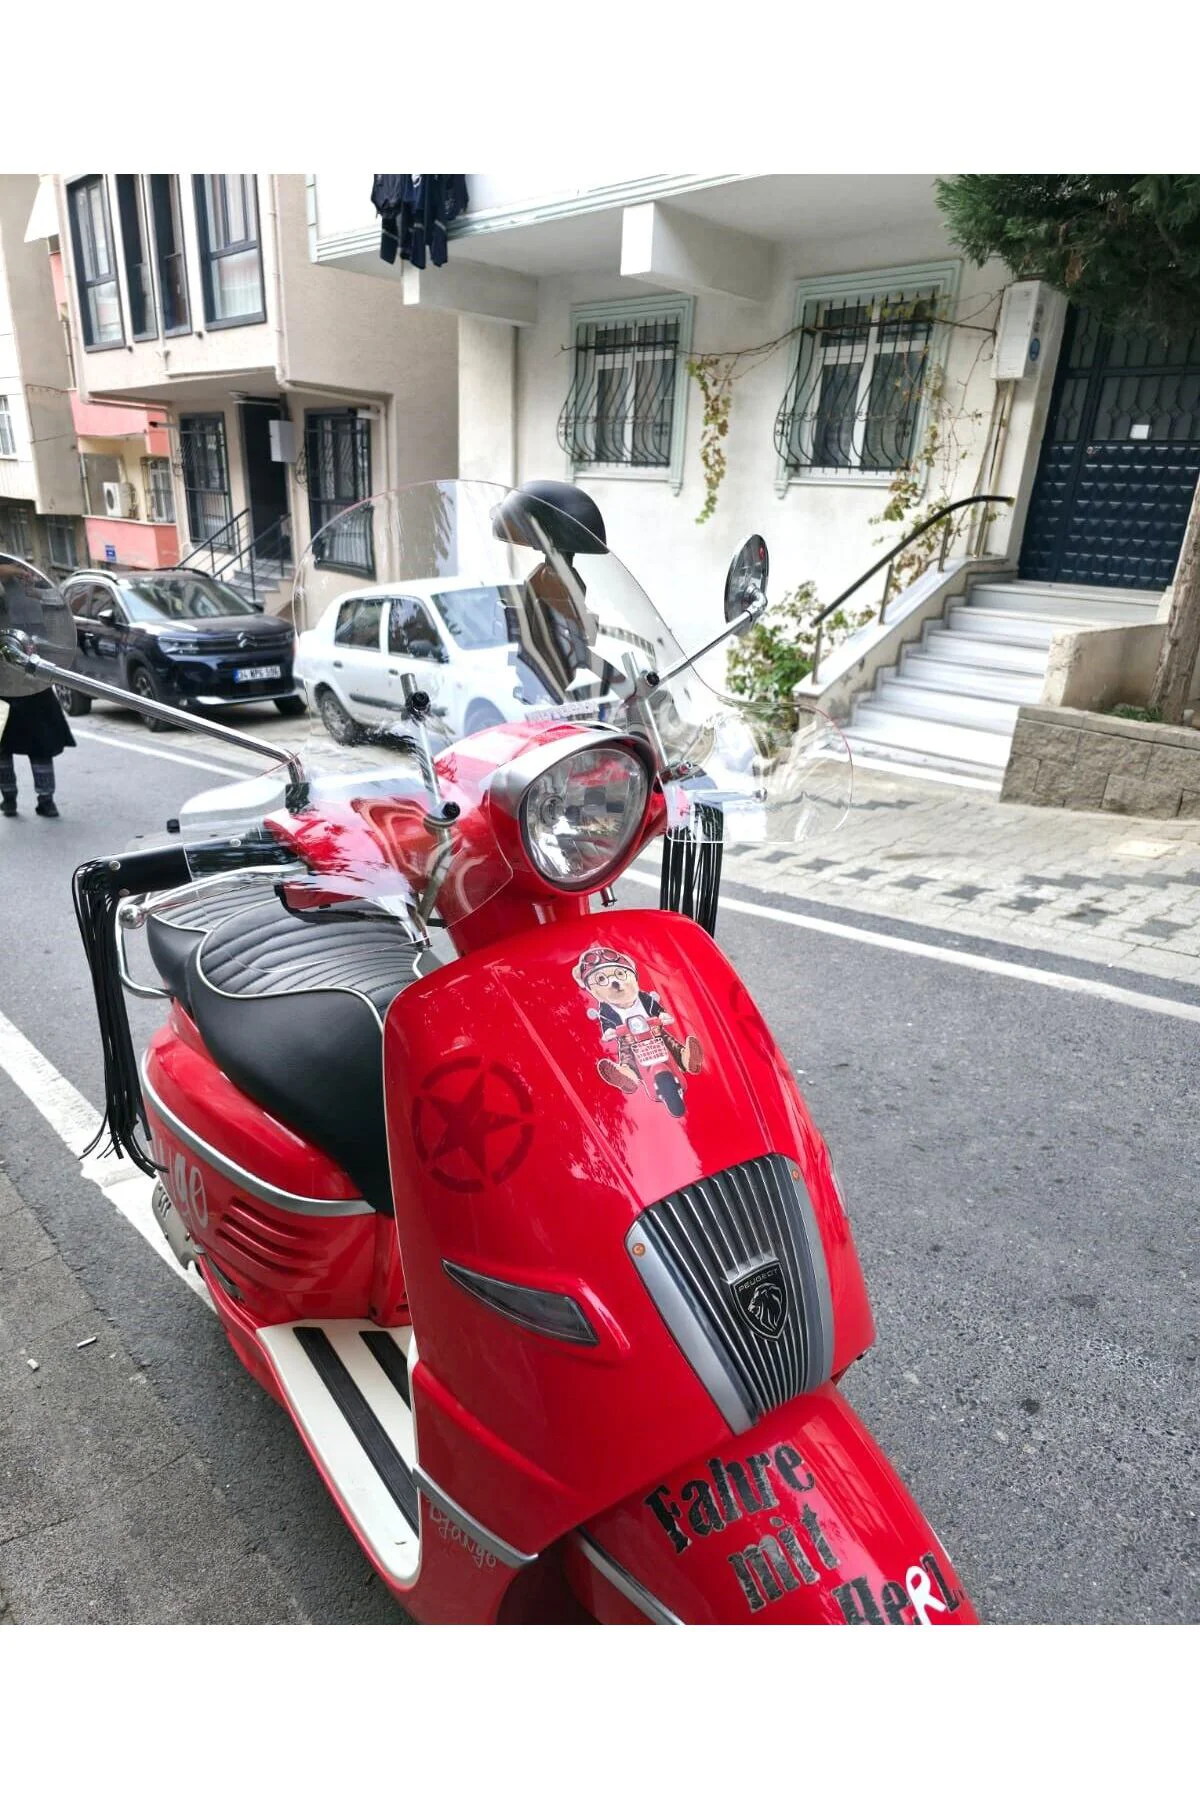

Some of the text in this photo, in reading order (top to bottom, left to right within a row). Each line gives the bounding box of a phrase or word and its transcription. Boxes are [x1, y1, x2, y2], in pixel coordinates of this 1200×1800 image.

[738, 1268, 778, 1291] PEUGEOT
[644, 1441, 815, 1554] Fahre
[728, 1502, 840, 1614] mit
